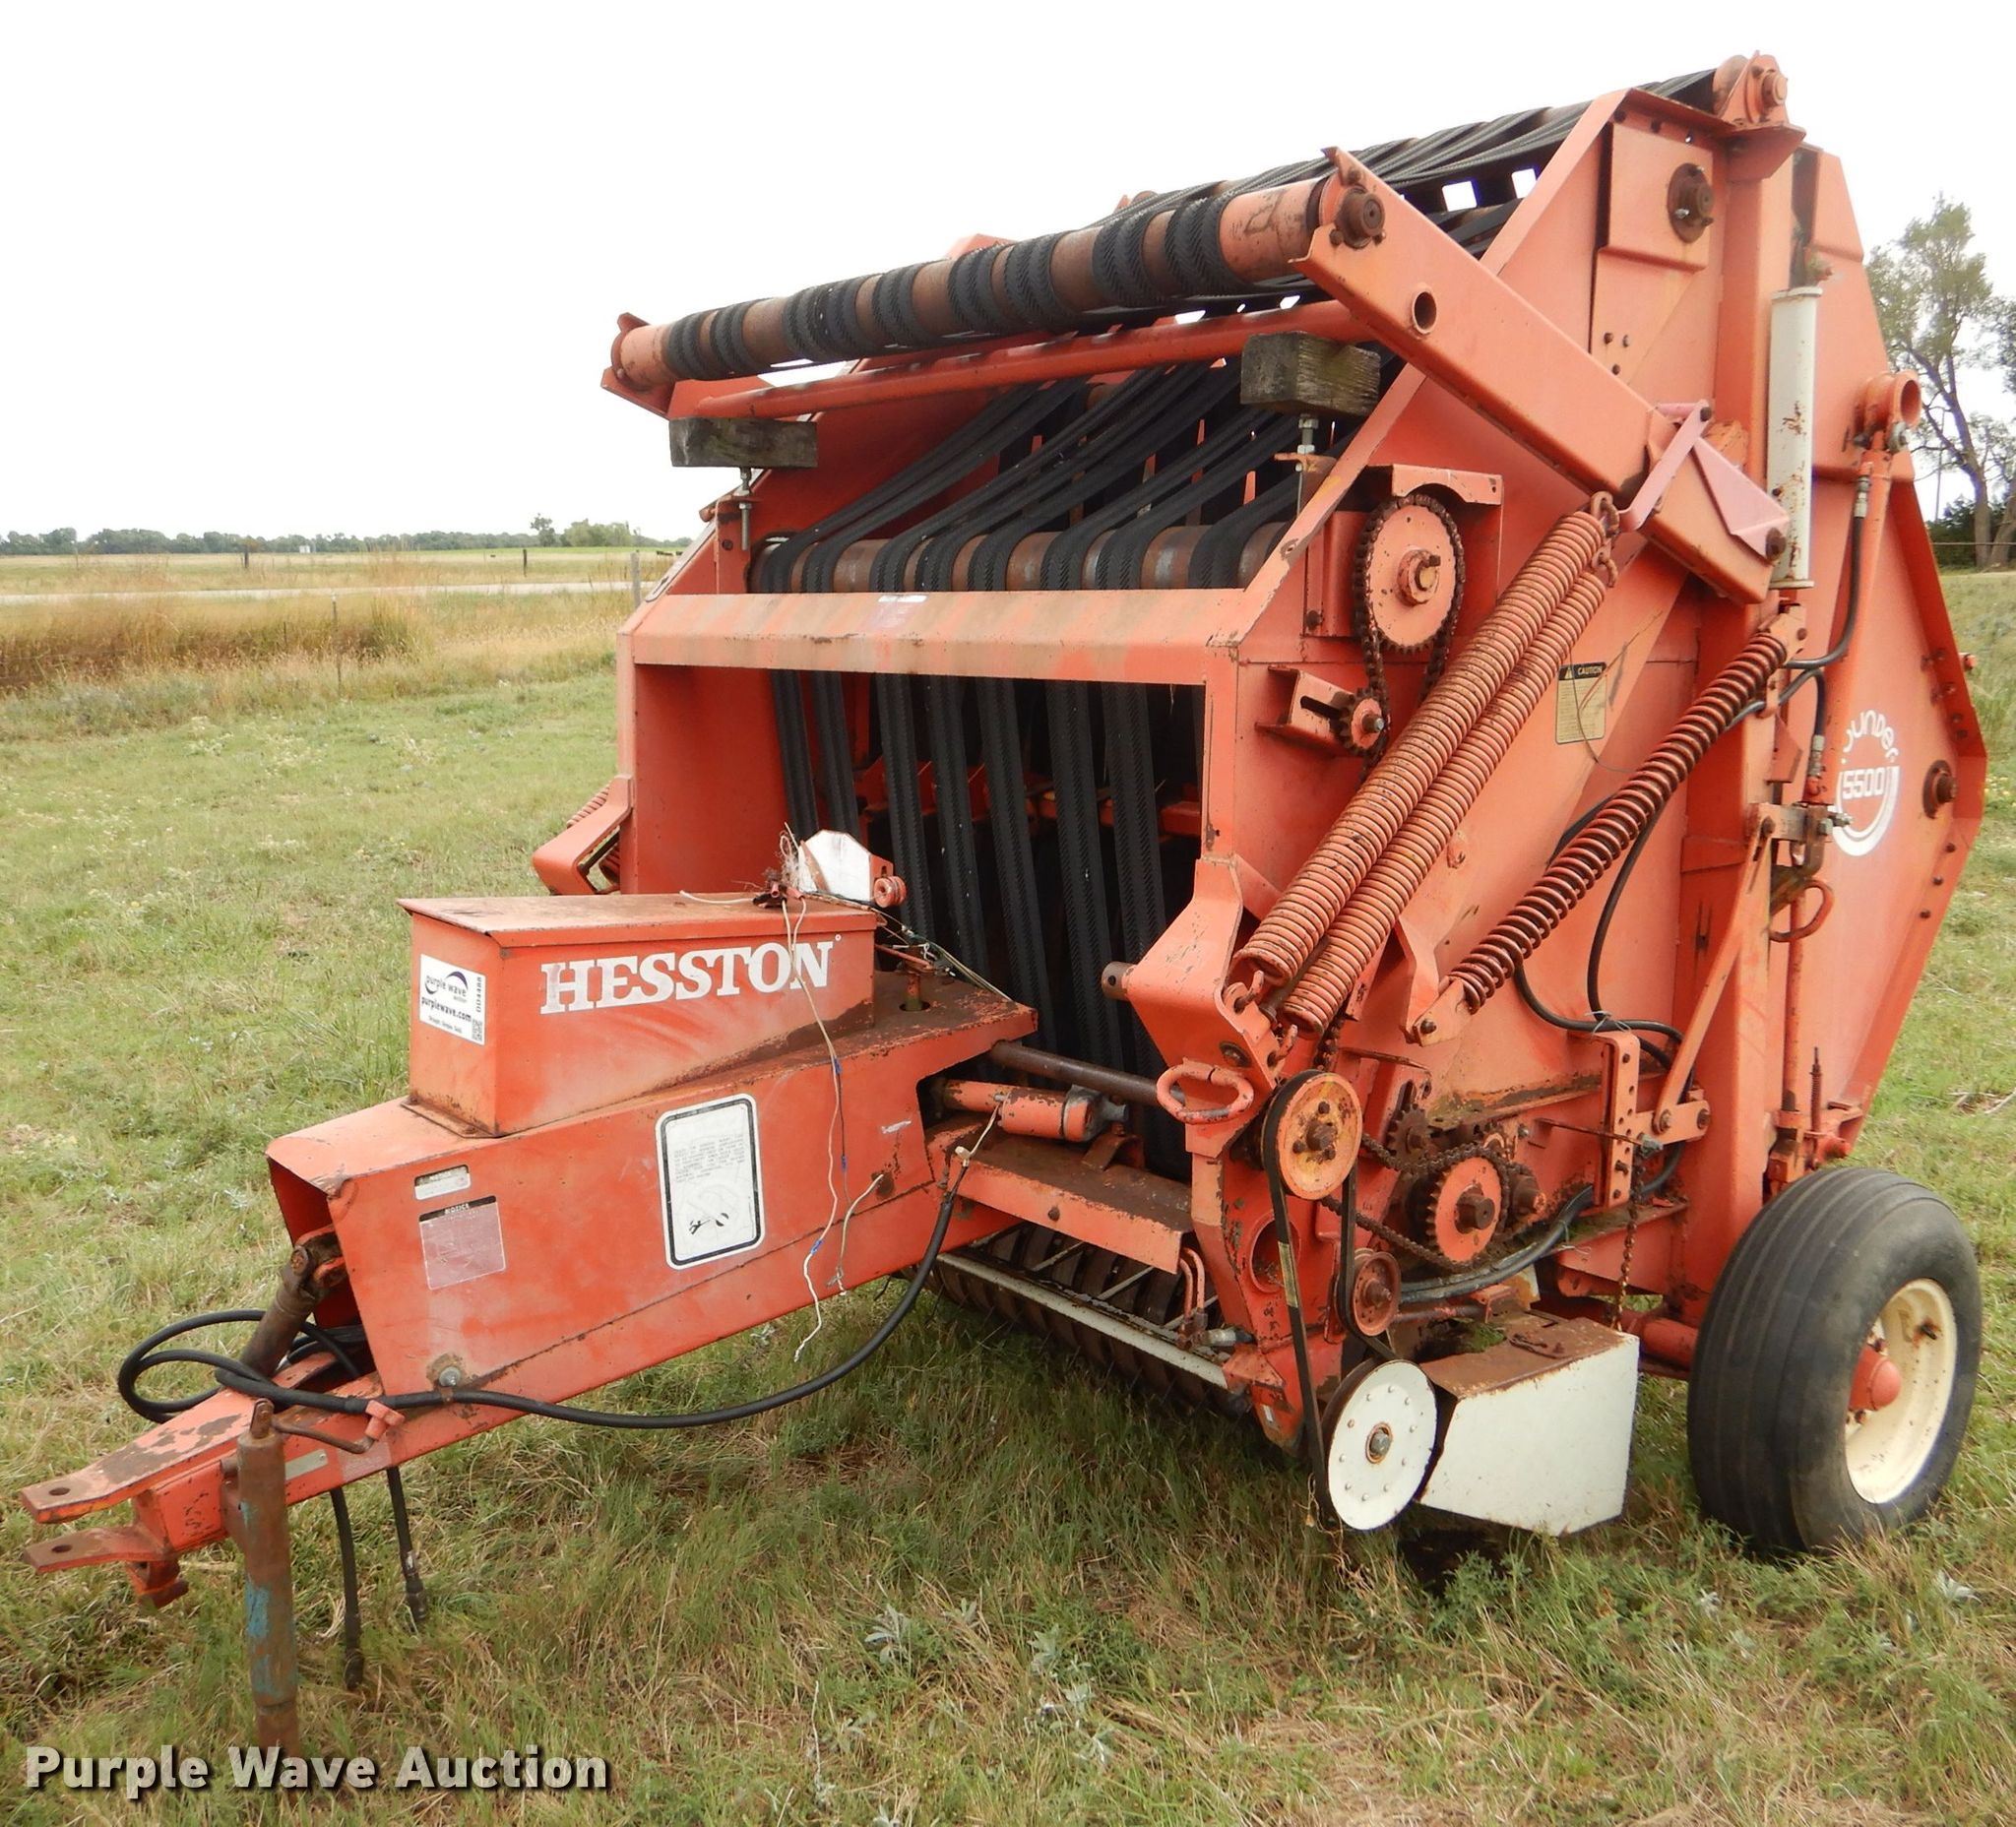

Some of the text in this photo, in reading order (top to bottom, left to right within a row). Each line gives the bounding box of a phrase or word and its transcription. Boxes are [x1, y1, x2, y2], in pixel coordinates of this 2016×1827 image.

[1843, 767, 1886, 800] 5500
[539, 942, 835, 1015] HESSTON
[421, 996, 472, 1022] purplewave.com
